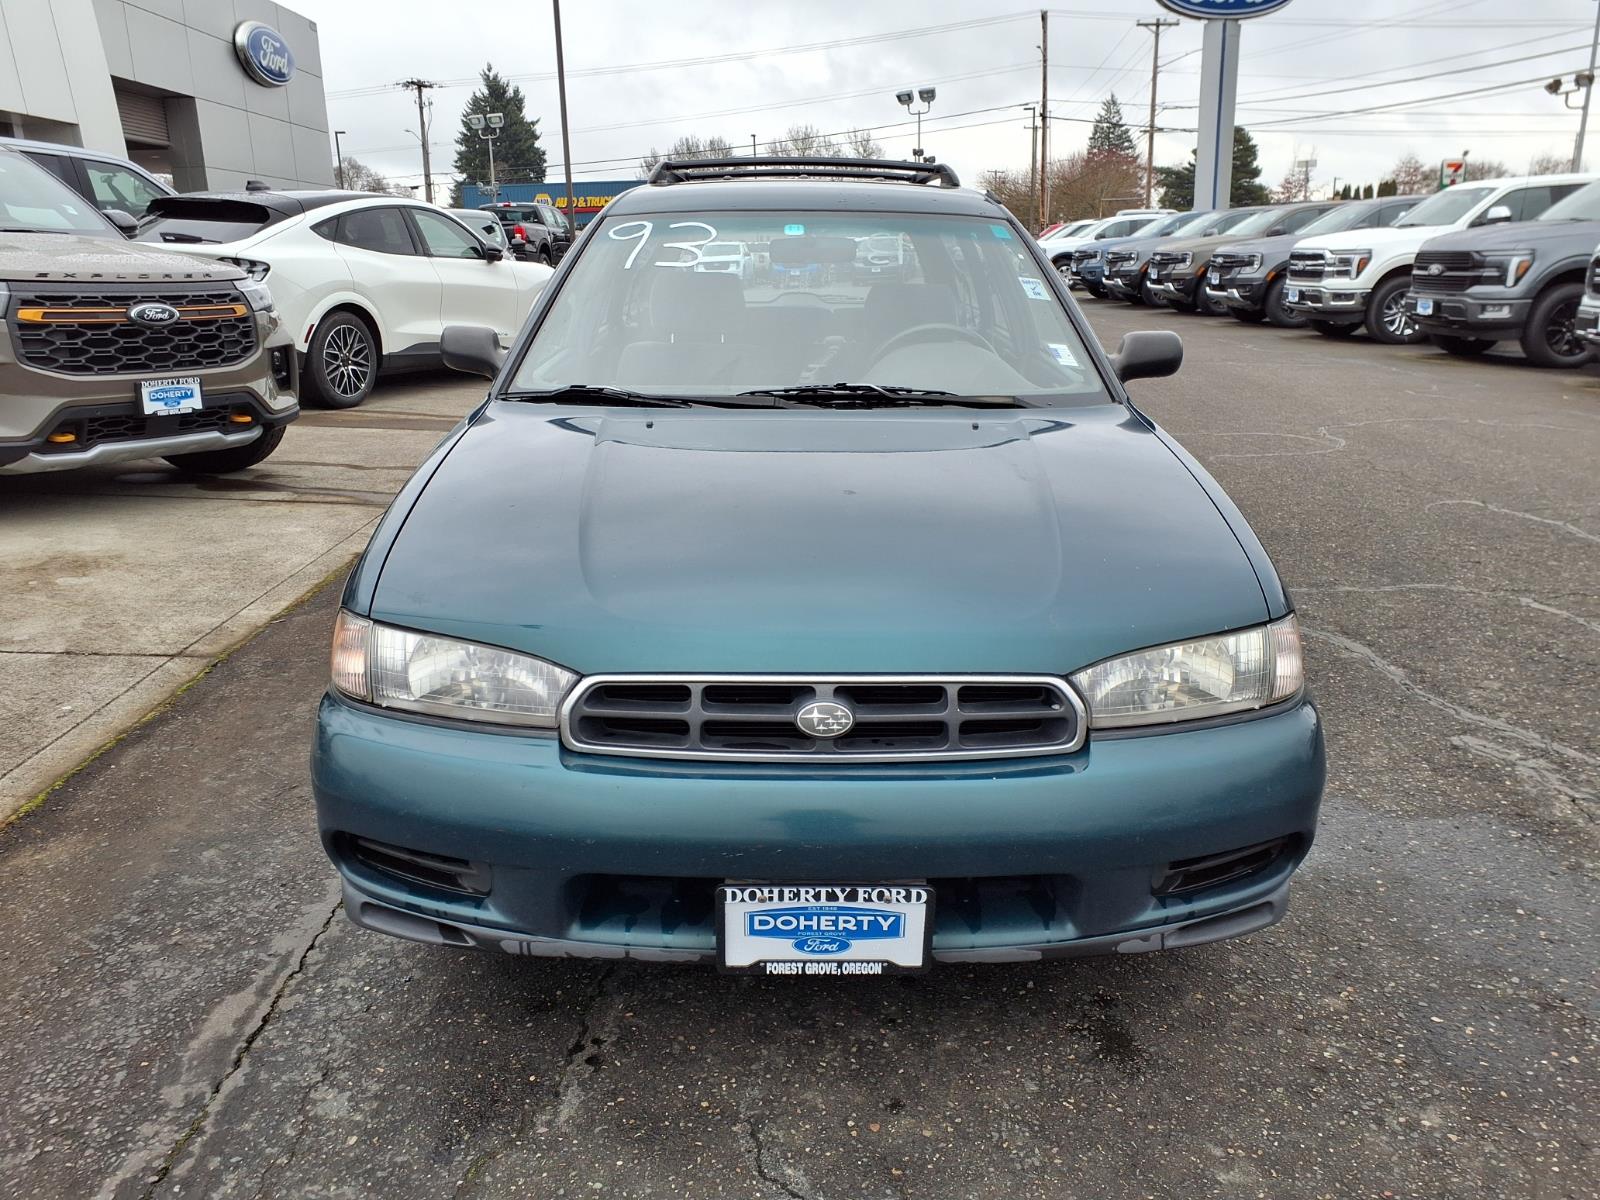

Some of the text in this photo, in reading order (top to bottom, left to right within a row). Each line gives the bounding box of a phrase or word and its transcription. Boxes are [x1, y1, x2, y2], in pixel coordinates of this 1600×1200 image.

[260, 35, 288, 74] Ford
[1447, 162, 1463, 185] 7
[555, 197, 577, 207] AUO
[609, 221, 717, 269] 93
[144, 308, 170, 320] Ford
[141, 377, 200, 388] DOHERTY FORD
[150, 390, 191, 399] DOHERTY
[724, 888, 927, 904] DOHERTY FORD
[754, 915, 896, 931] DOHERTY
[803, 938, 839, 952] Ford
[766, 962, 882, 975] FOREST GROVE, OREGON
